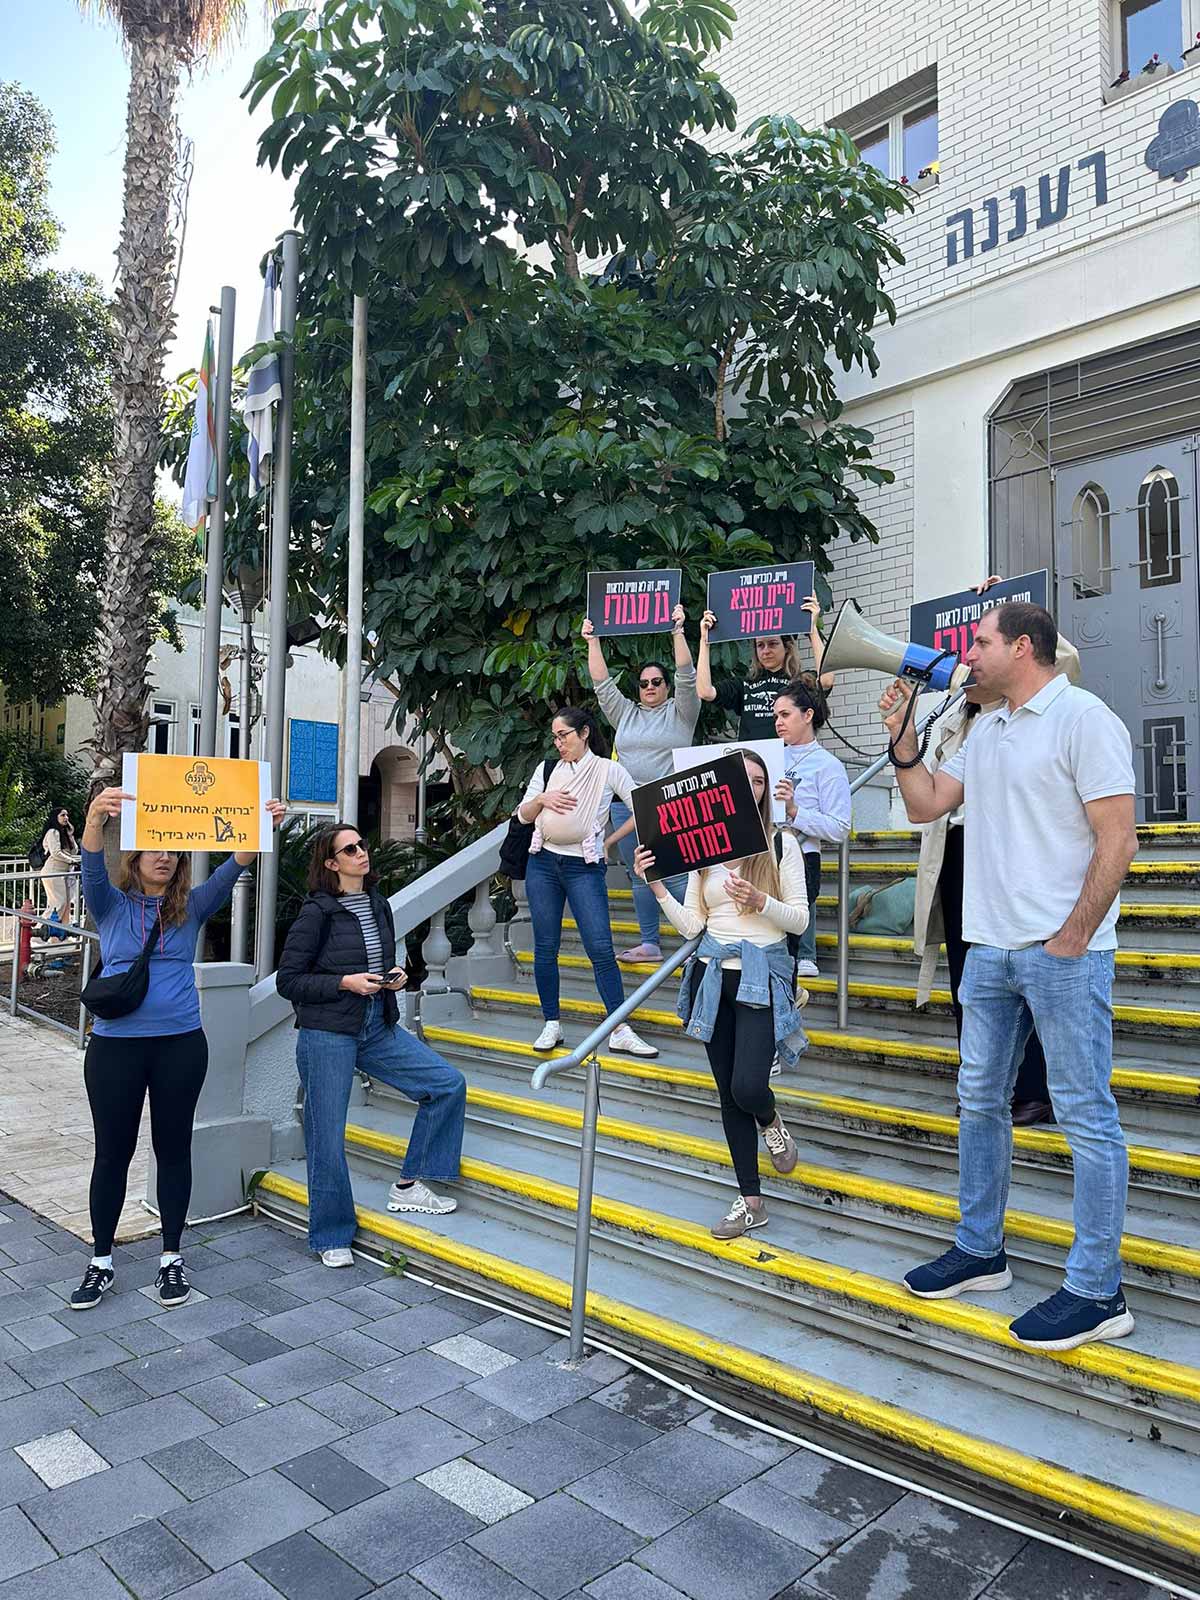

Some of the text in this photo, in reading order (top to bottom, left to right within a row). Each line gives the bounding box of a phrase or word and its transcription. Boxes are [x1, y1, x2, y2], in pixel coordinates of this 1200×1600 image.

[946, 150, 1108, 267] רעננה
[730, 582, 796, 610] היית מוצא
[604, 591, 670, 625] גן סגור!
[935, 608, 961, 629] לראות
[740, 607, 783, 633] פתרון!
[700, 770, 718, 789] חיים,
[661, 783, 677, 800] שלך
[142, 802, 158, 813] על
[160, 804, 209, 814] האחריות
[656, 784, 737, 836] היית מוצא
[186, 831, 206, 840] היא
[238, 832, 247, 843] גן
[676, 821, 733, 864] פתרון!
